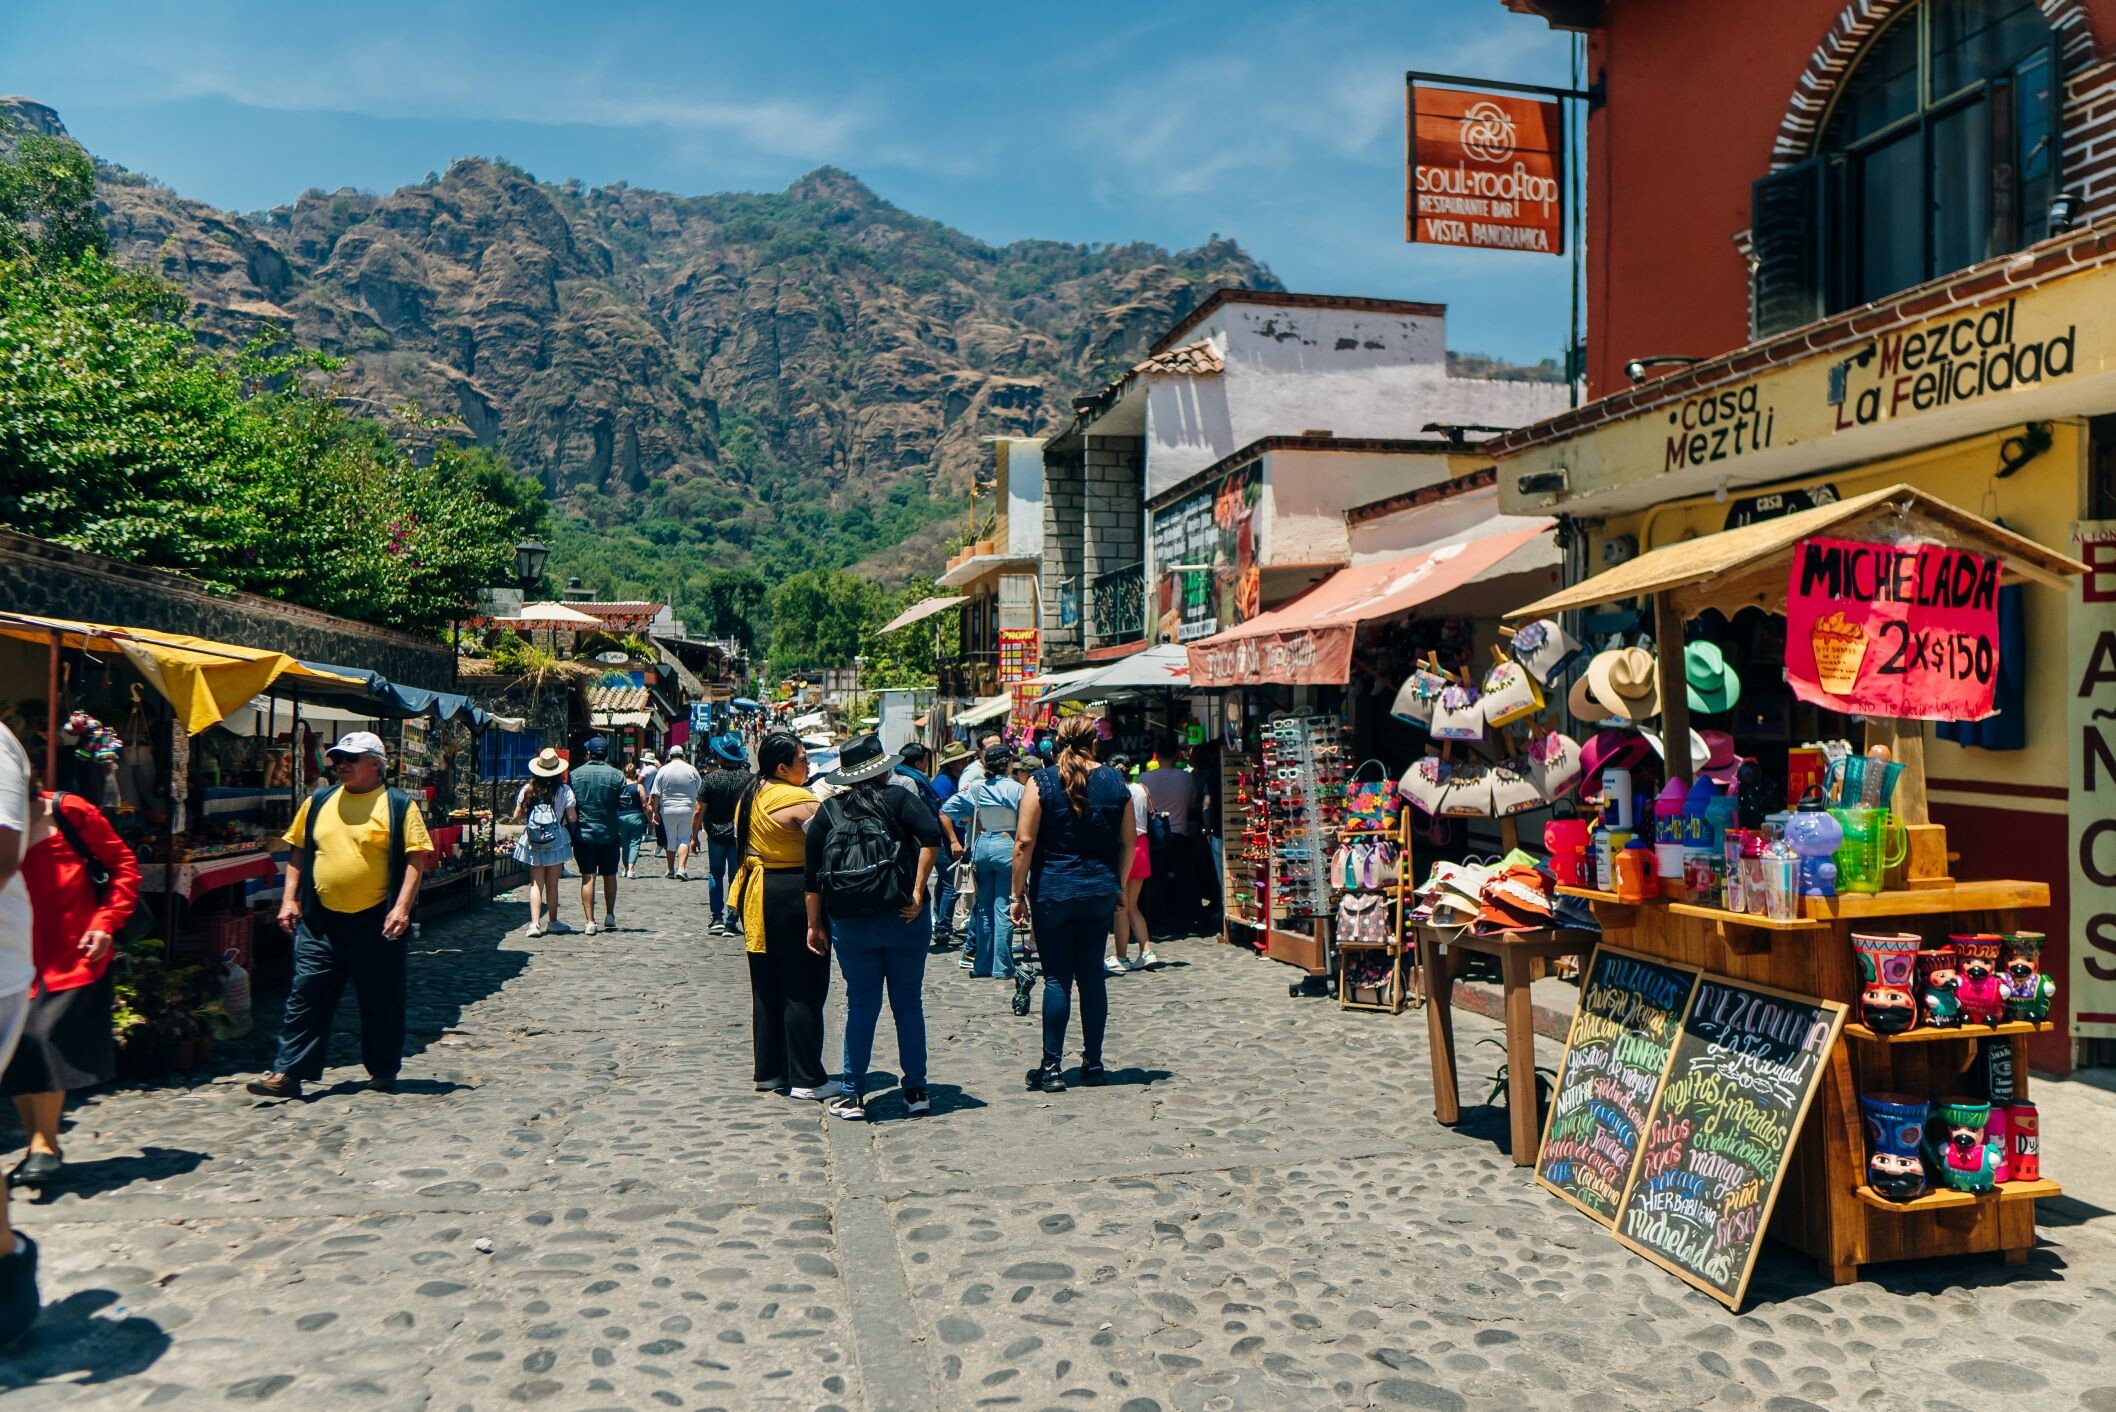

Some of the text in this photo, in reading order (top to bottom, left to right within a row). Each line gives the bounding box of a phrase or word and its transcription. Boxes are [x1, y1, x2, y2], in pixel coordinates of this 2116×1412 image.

[1418, 194, 1513, 219] RESTAURANTE BAR
[1426, 218, 1549, 251] VISTA PANORAMICA
[1879, 298, 2016, 379] Mezcal
[1890, 325, 2076, 417] Felicidad
[1665, 406, 1773, 472] Meztli
[1800, 544, 1997, 610] MICHELADA
[1566, 1046, 1608, 1087] gusano
[1607, 1048, 1622, 1078] de
[1616, 1034, 1671, 1074] CANNABIS
[1557, 1078, 1594, 1118] NATURAL
[1663, 1071, 1721, 1115] mojitos
